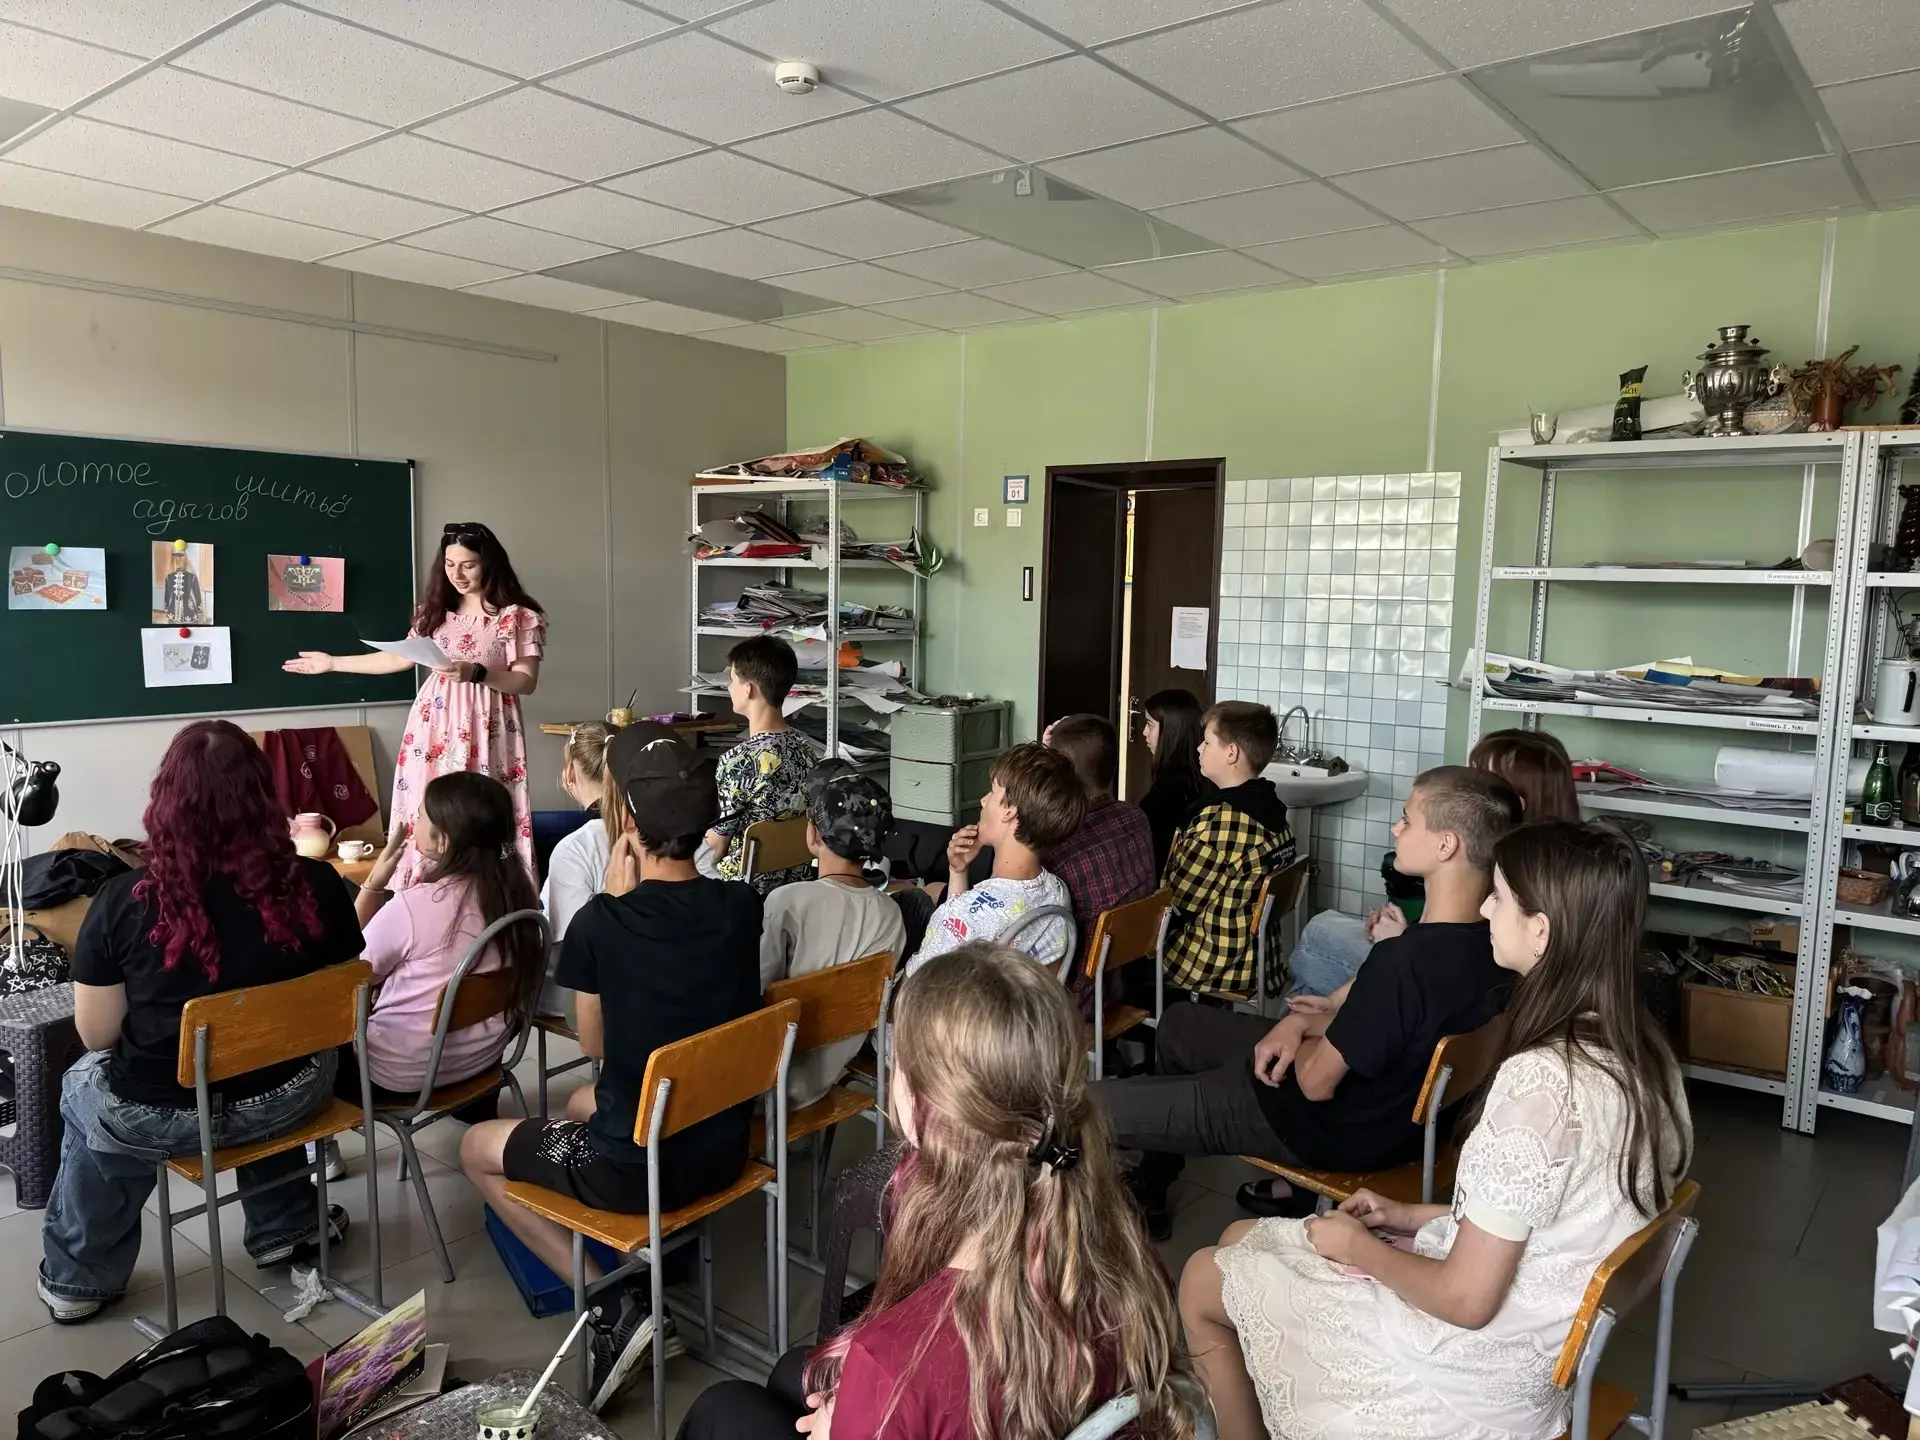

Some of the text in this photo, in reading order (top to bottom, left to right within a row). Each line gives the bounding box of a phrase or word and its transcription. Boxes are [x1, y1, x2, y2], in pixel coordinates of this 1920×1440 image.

[133, 490, 249, 535] адыгов
[235, 474, 352, 518] шитьё
[1011, 489, 1020, 498] 01
